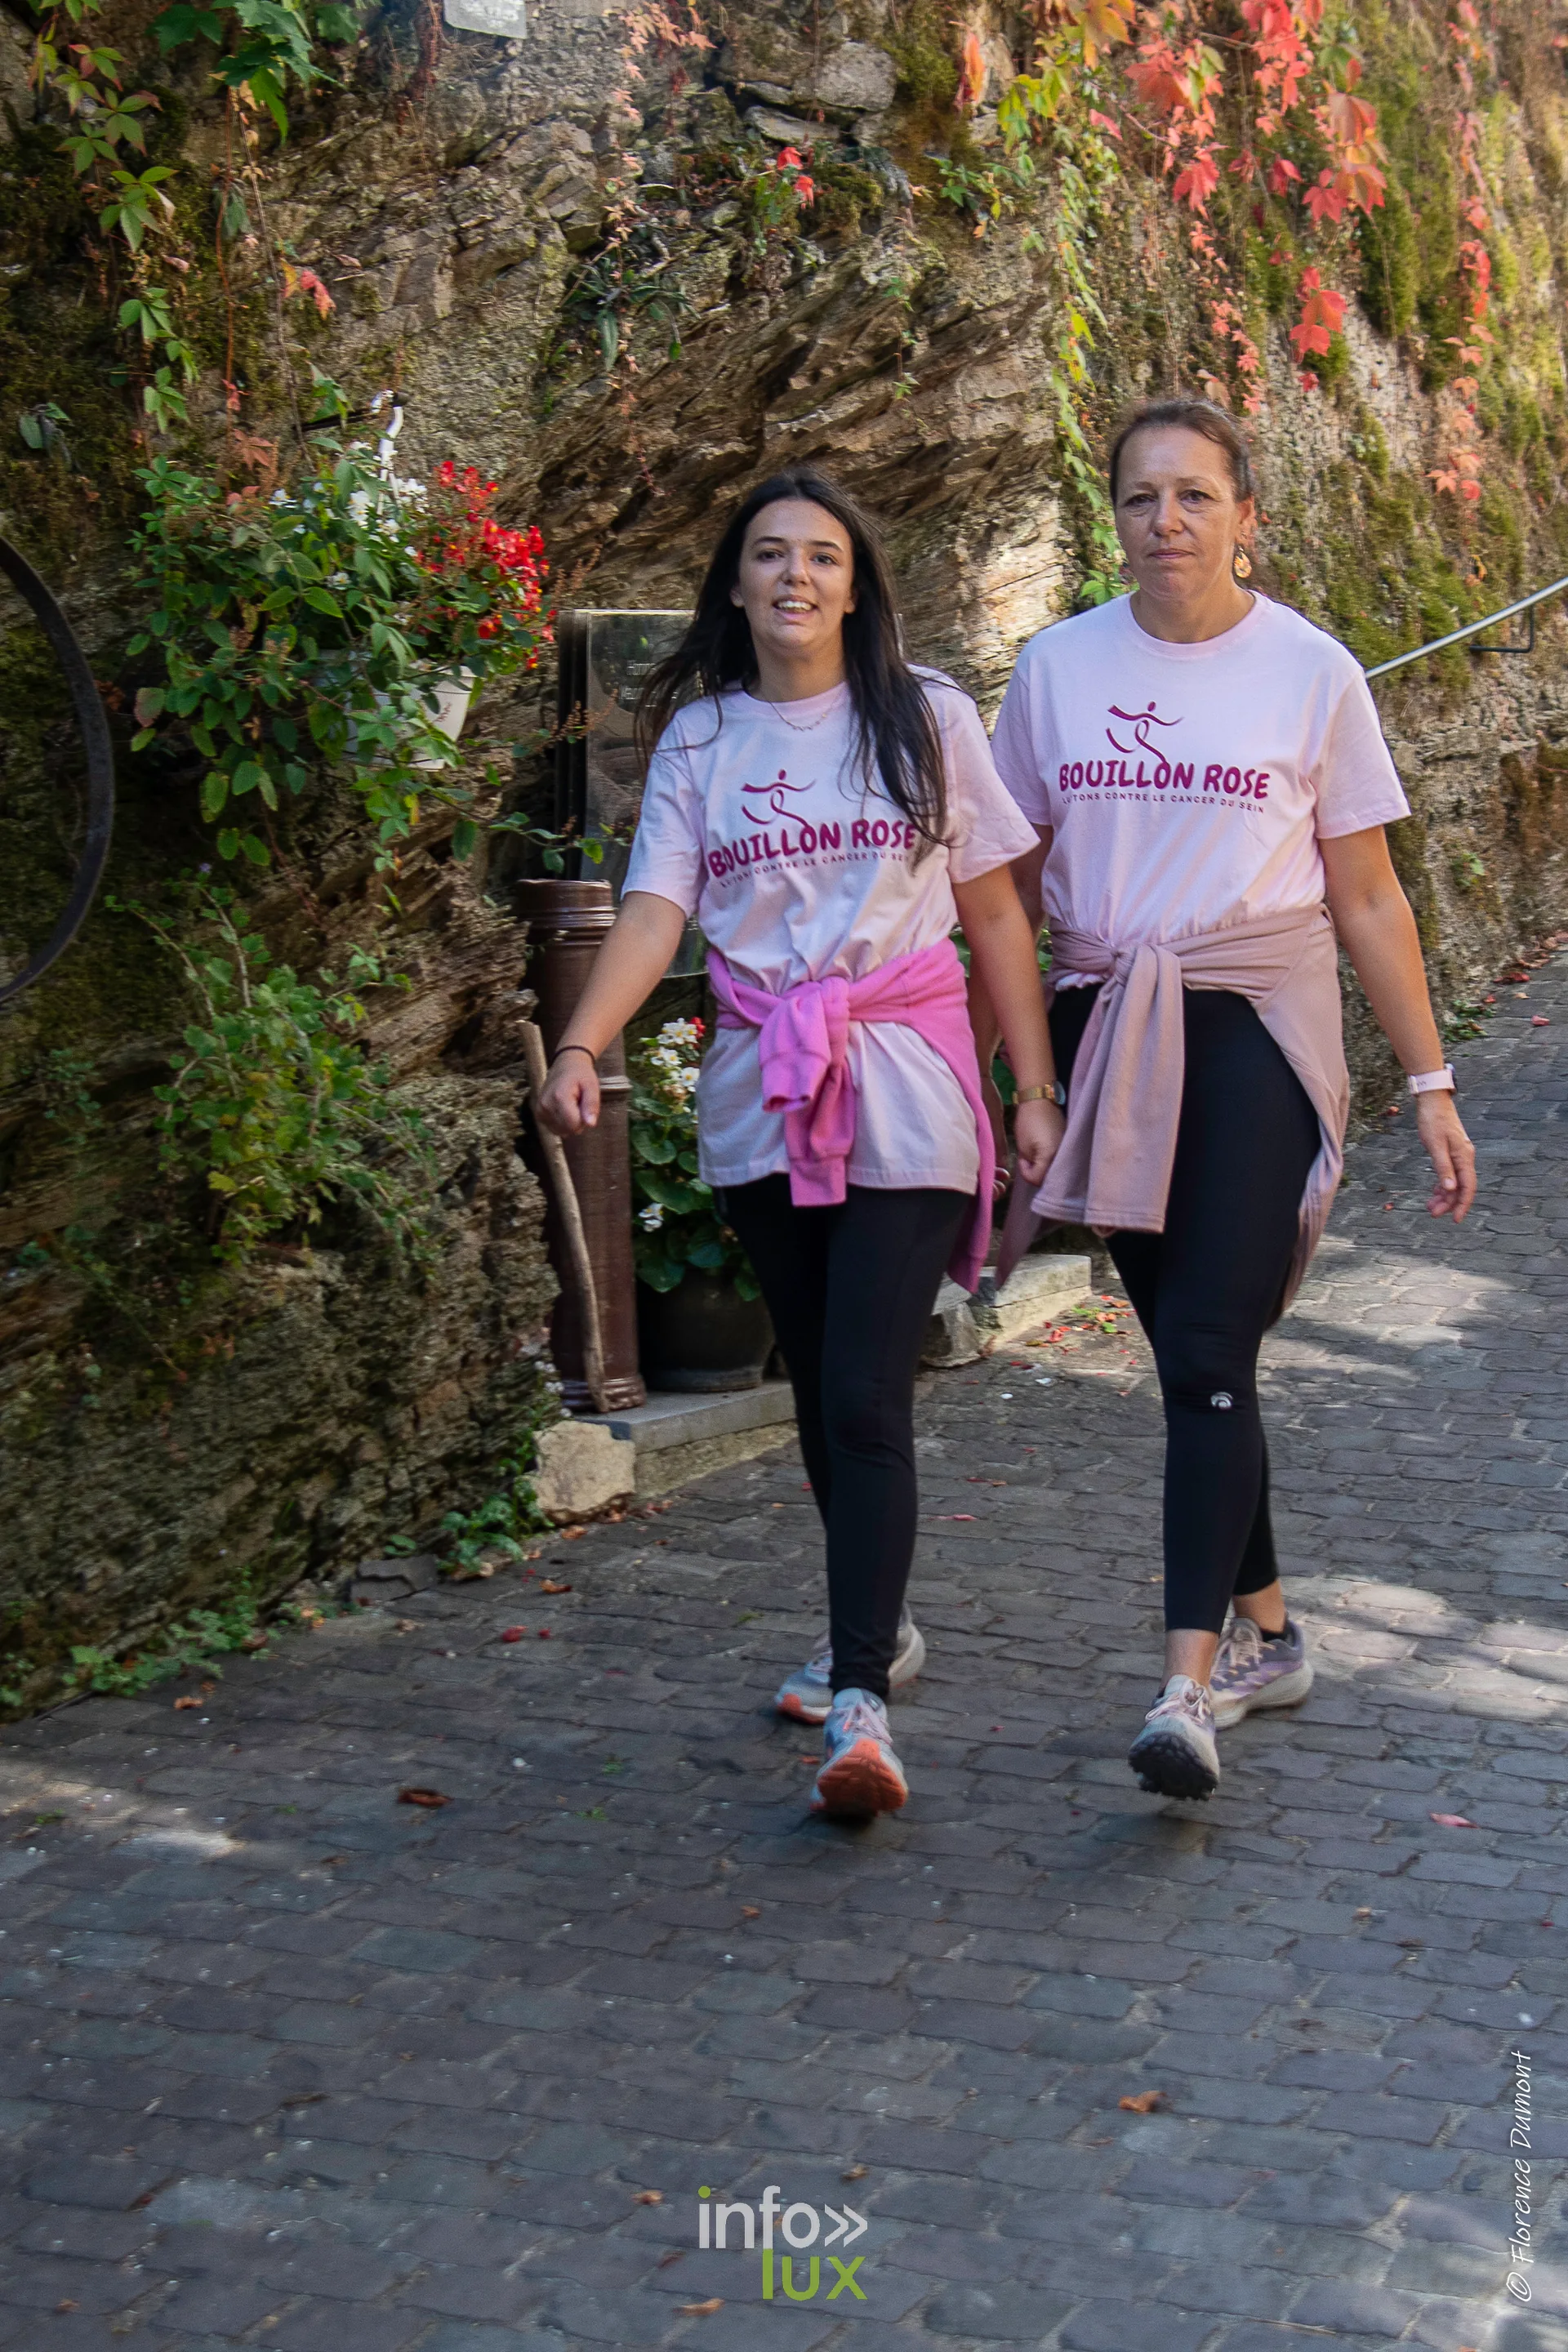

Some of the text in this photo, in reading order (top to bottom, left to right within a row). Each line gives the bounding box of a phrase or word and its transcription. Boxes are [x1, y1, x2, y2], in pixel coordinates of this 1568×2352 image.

[1059, 760, 1271, 800] BOUILLON ROSE
[1104, 791, 1148, 801] CONTRE
[1152, 794, 1165, 802] LE
[1170, 794, 1215, 804] CANCER
[1220, 798, 1234, 807] DU
[1239, 801, 1264, 813] SEIN
[708, 818, 917, 878] BOUILLON ROSE
[804, 858, 817, 866] LE
[822, 852, 867, 864] CANCER
